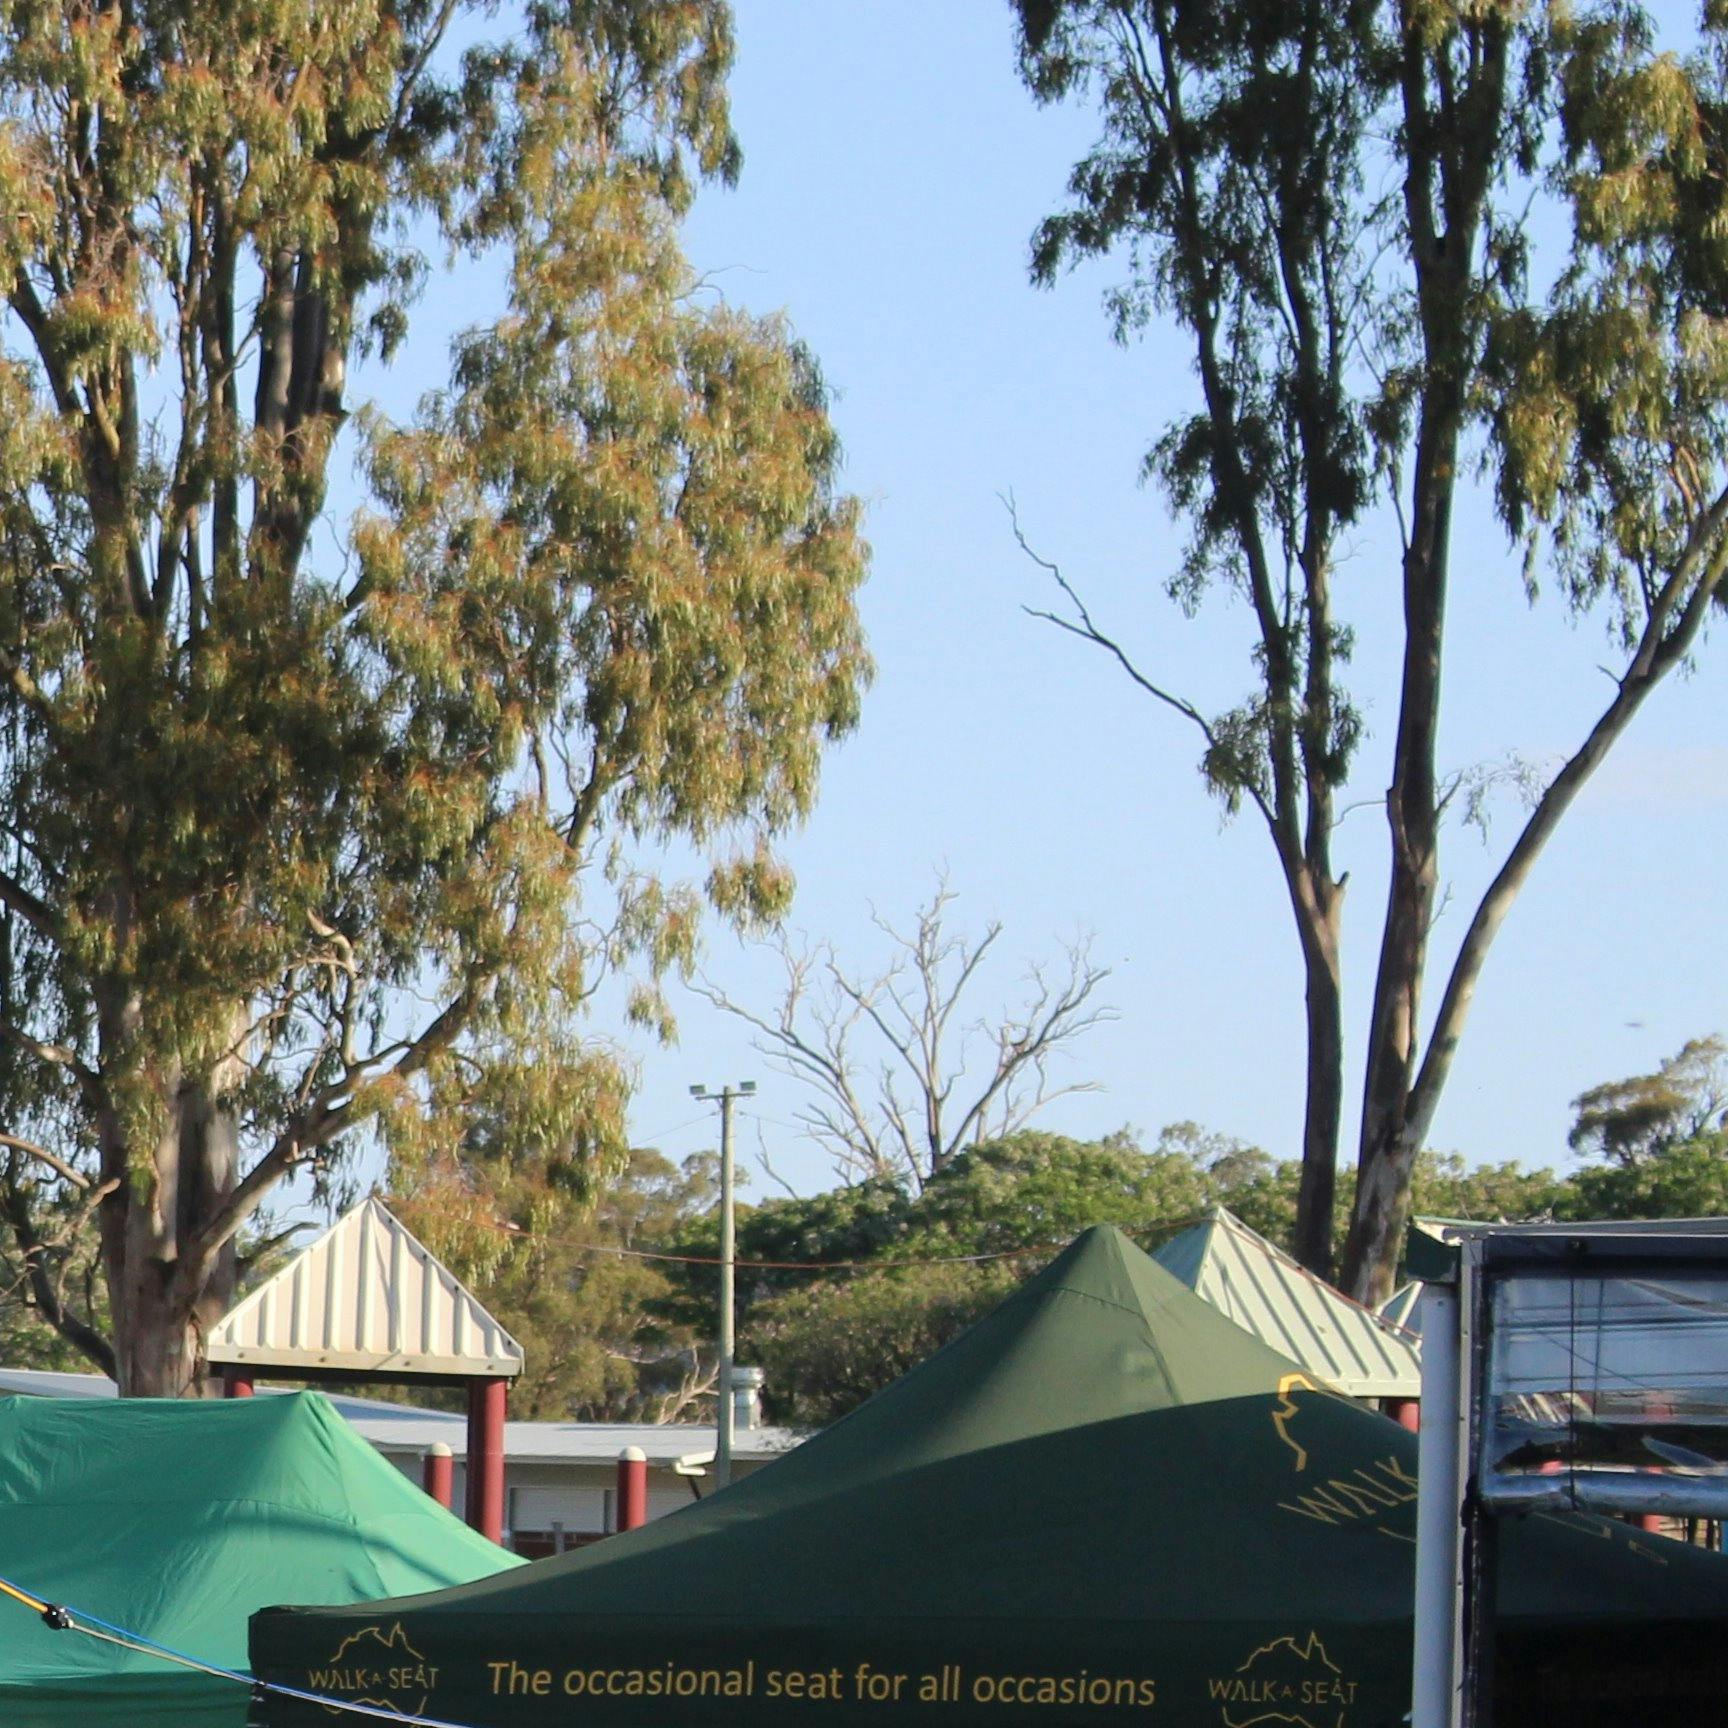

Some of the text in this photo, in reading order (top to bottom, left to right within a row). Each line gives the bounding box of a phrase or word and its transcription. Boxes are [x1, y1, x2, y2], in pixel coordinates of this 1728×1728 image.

[309, 1669, 369, 1690] WALK
[388, 1664, 440, 1690] SEAT
[489, 1662, 1155, 1706] The occasional seat for all occasions
[1208, 1679, 1276, 1703] WALK
[1301, 1677, 1358, 1705] SEAT
